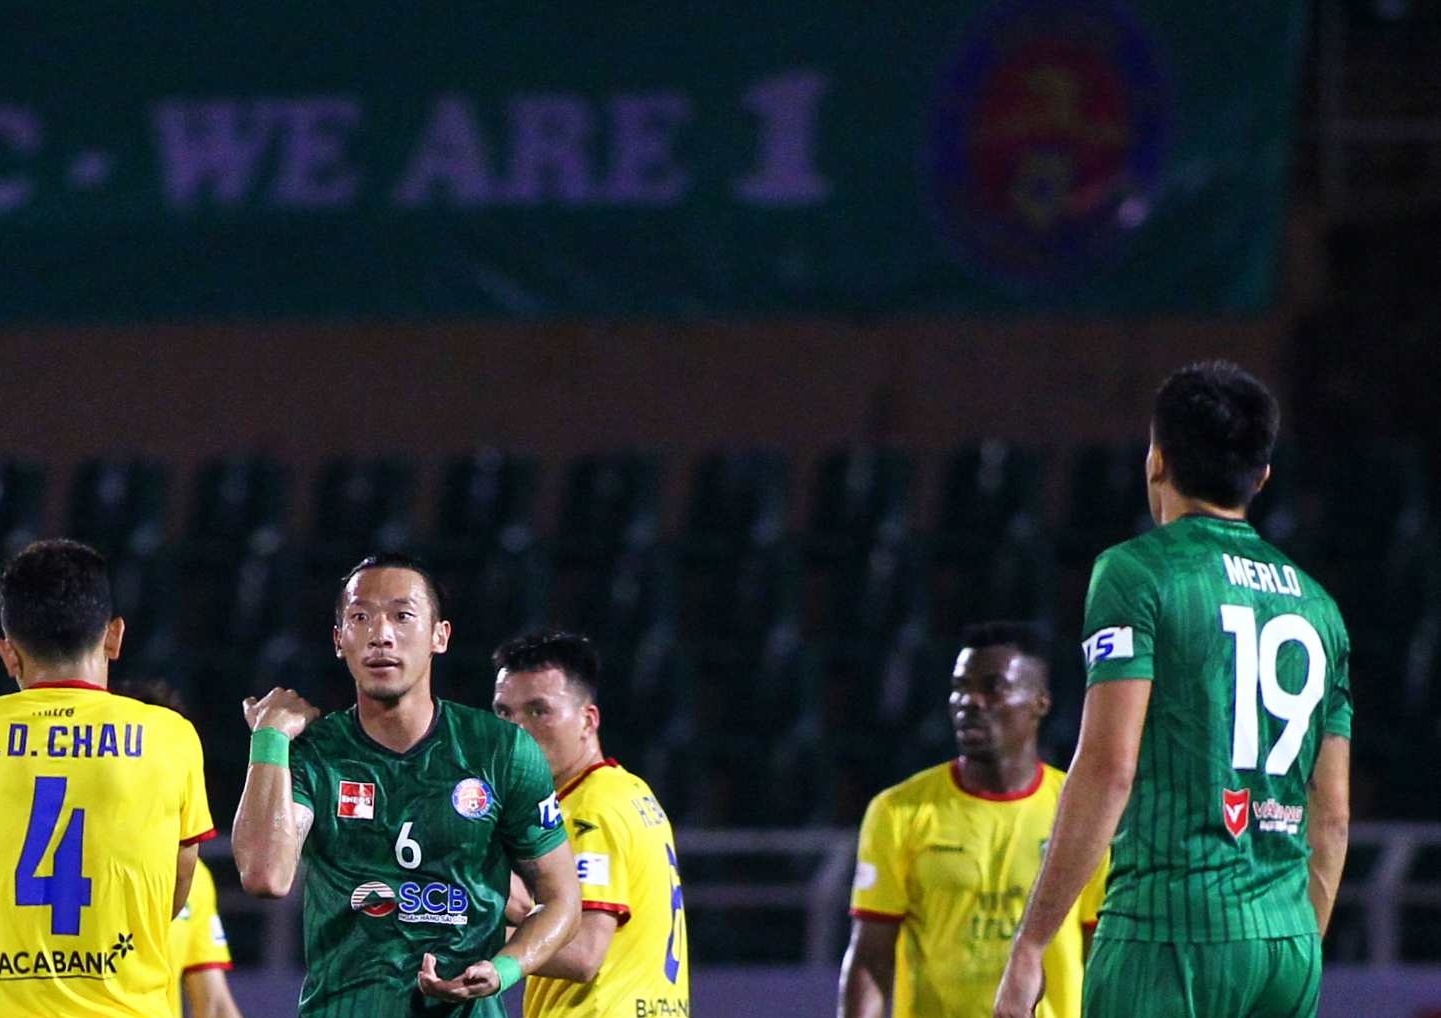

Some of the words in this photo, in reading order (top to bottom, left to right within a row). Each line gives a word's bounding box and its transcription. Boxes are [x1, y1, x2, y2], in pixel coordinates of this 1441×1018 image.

[150, 96, 361, 207] WE
[396, 91, 689, 203] ARE
[732, 70, 827, 203] 1
[1223, 553, 1302, 597] MERLO
[1220, 604, 1327, 776] 19
[15, 776, 92, 936] 4
[395, 822, 422, 869] 6
[398, 881, 469, 914] SCB
